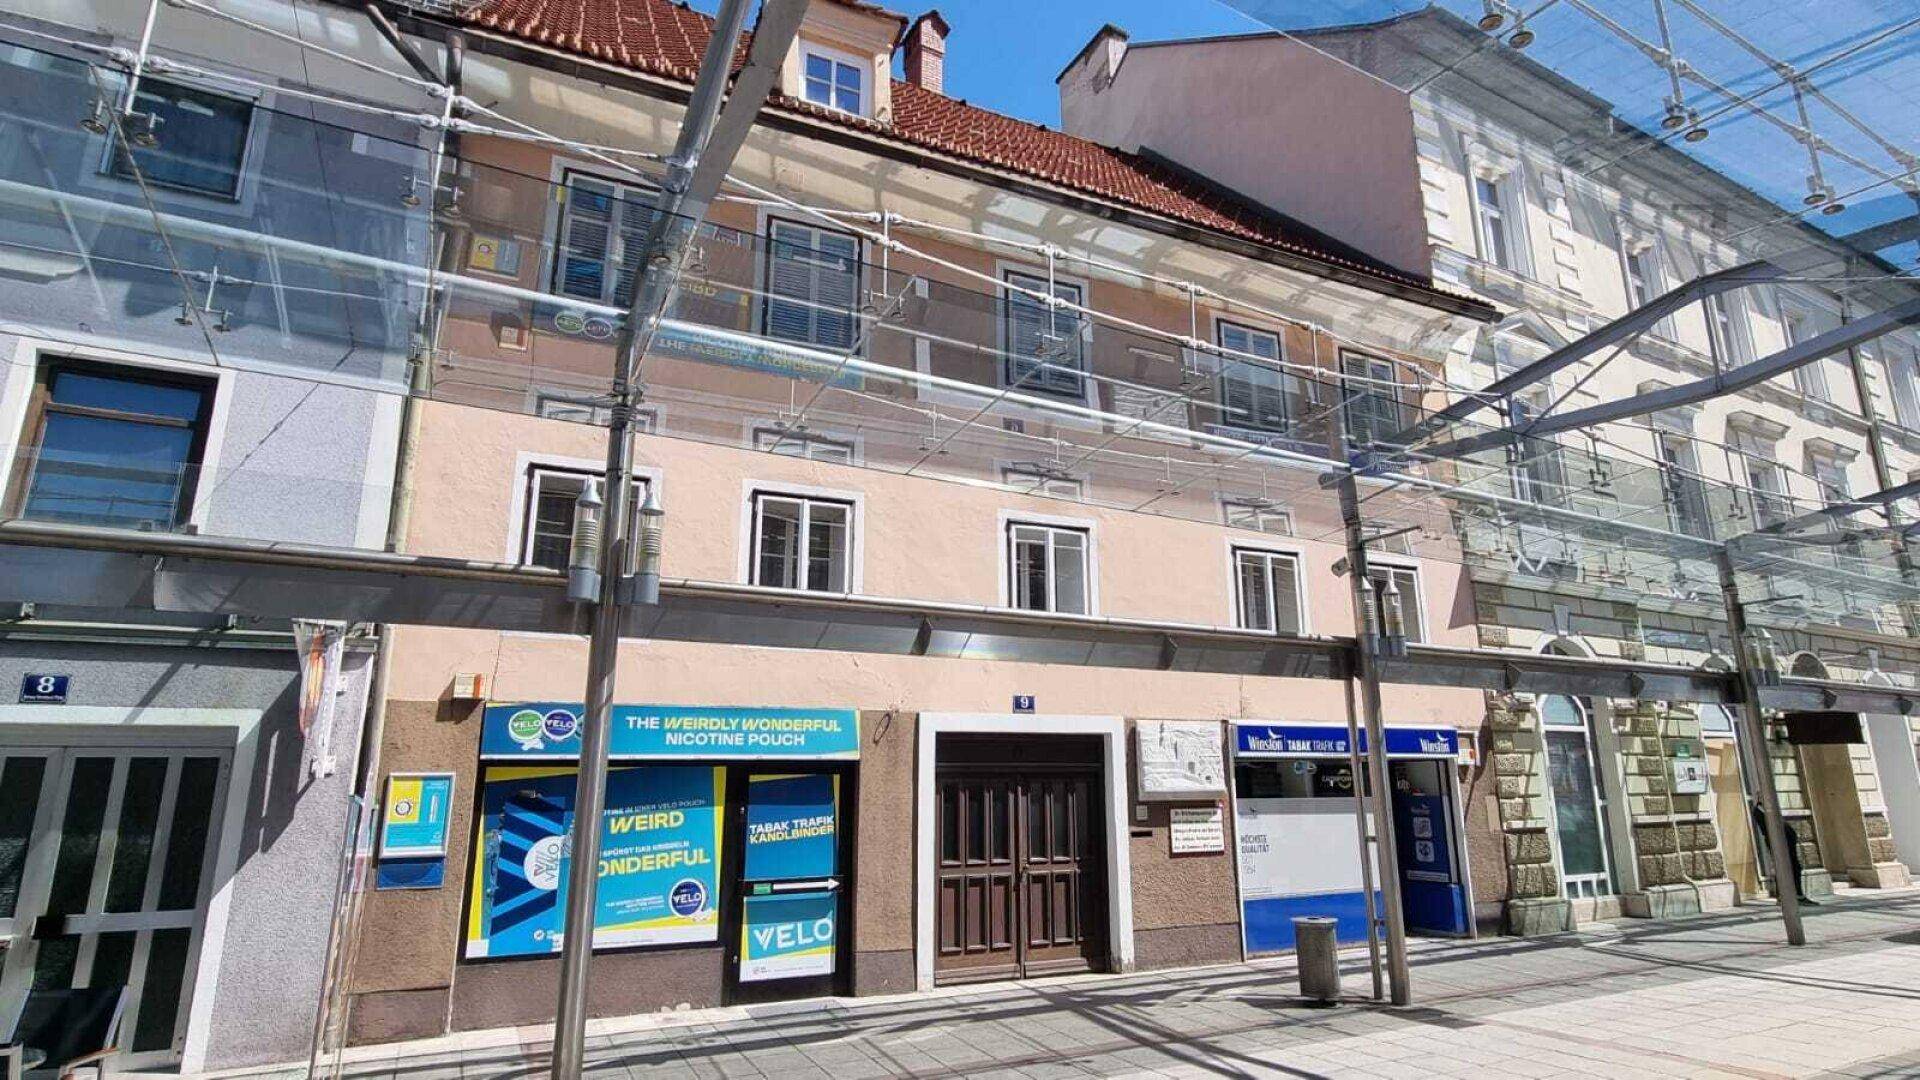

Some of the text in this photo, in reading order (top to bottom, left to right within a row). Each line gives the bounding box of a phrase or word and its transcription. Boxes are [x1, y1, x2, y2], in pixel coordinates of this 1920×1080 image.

[36, 676, 56, 693] 8
[1020, 696, 1030, 709] 9
[512, 719, 542, 728] VELO
[545, 719, 574, 728] VELO
[625, 716, 842, 732] THE WEIRDLY WONDERFUL
[665, 732, 806, 746] NICOTINE POUCH
[1248, 735, 1284, 751] Winston
[1287, 739, 1312, 751] TABAK
[1420, 738, 1450, 751] Winston
[609, 810, 685, 835] WEIRD
[749, 815, 834, 835] TABAK TRAFIK
[749, 825, 835, 845] KANDLBINDER
[545, 843, 560, 883] VELO
[598, 847, 711, 878] ONDERFUL
[672, 892, 702, 904] VELO
[753, 914, 834, 952] VELO
